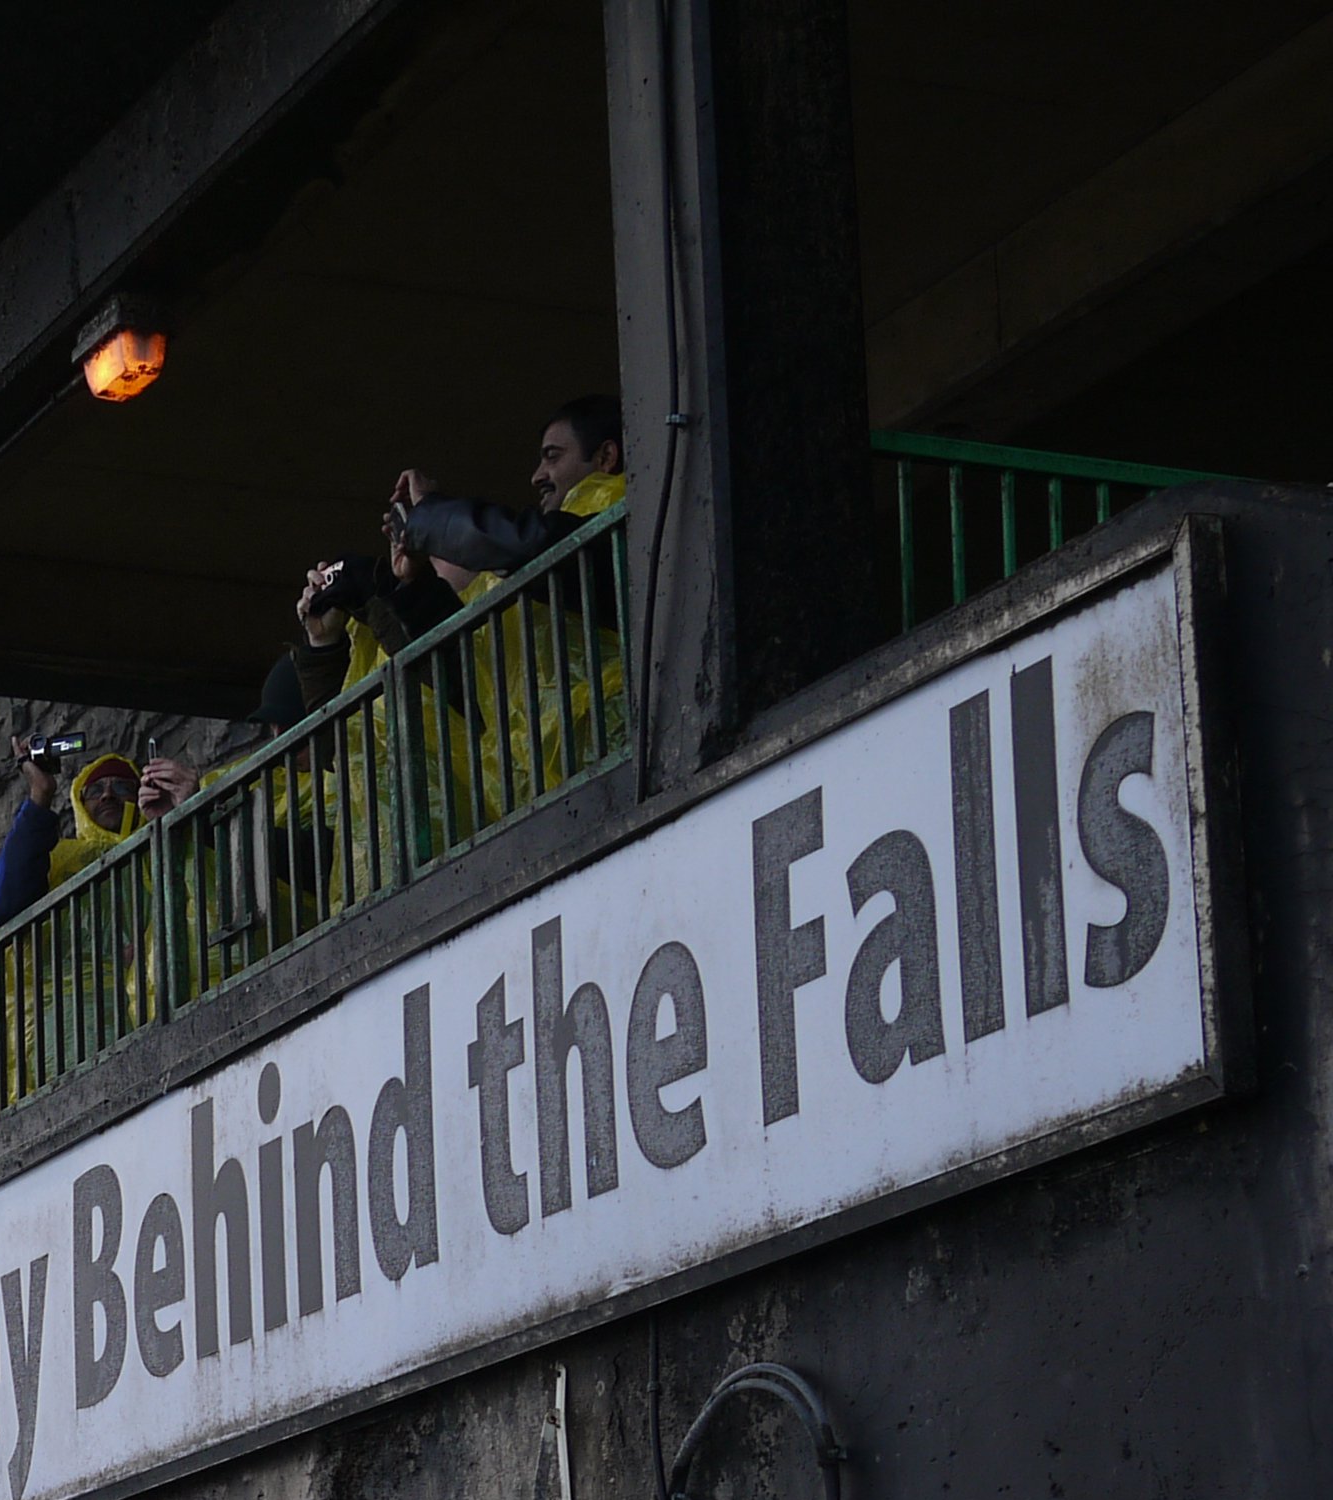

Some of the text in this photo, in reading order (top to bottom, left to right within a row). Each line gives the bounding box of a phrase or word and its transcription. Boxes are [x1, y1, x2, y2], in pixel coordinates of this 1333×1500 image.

[73, 982, 440, 1411] Behind
[467, 914, 709, 1240] the
[751, 654, 1171, 1131] Falls
